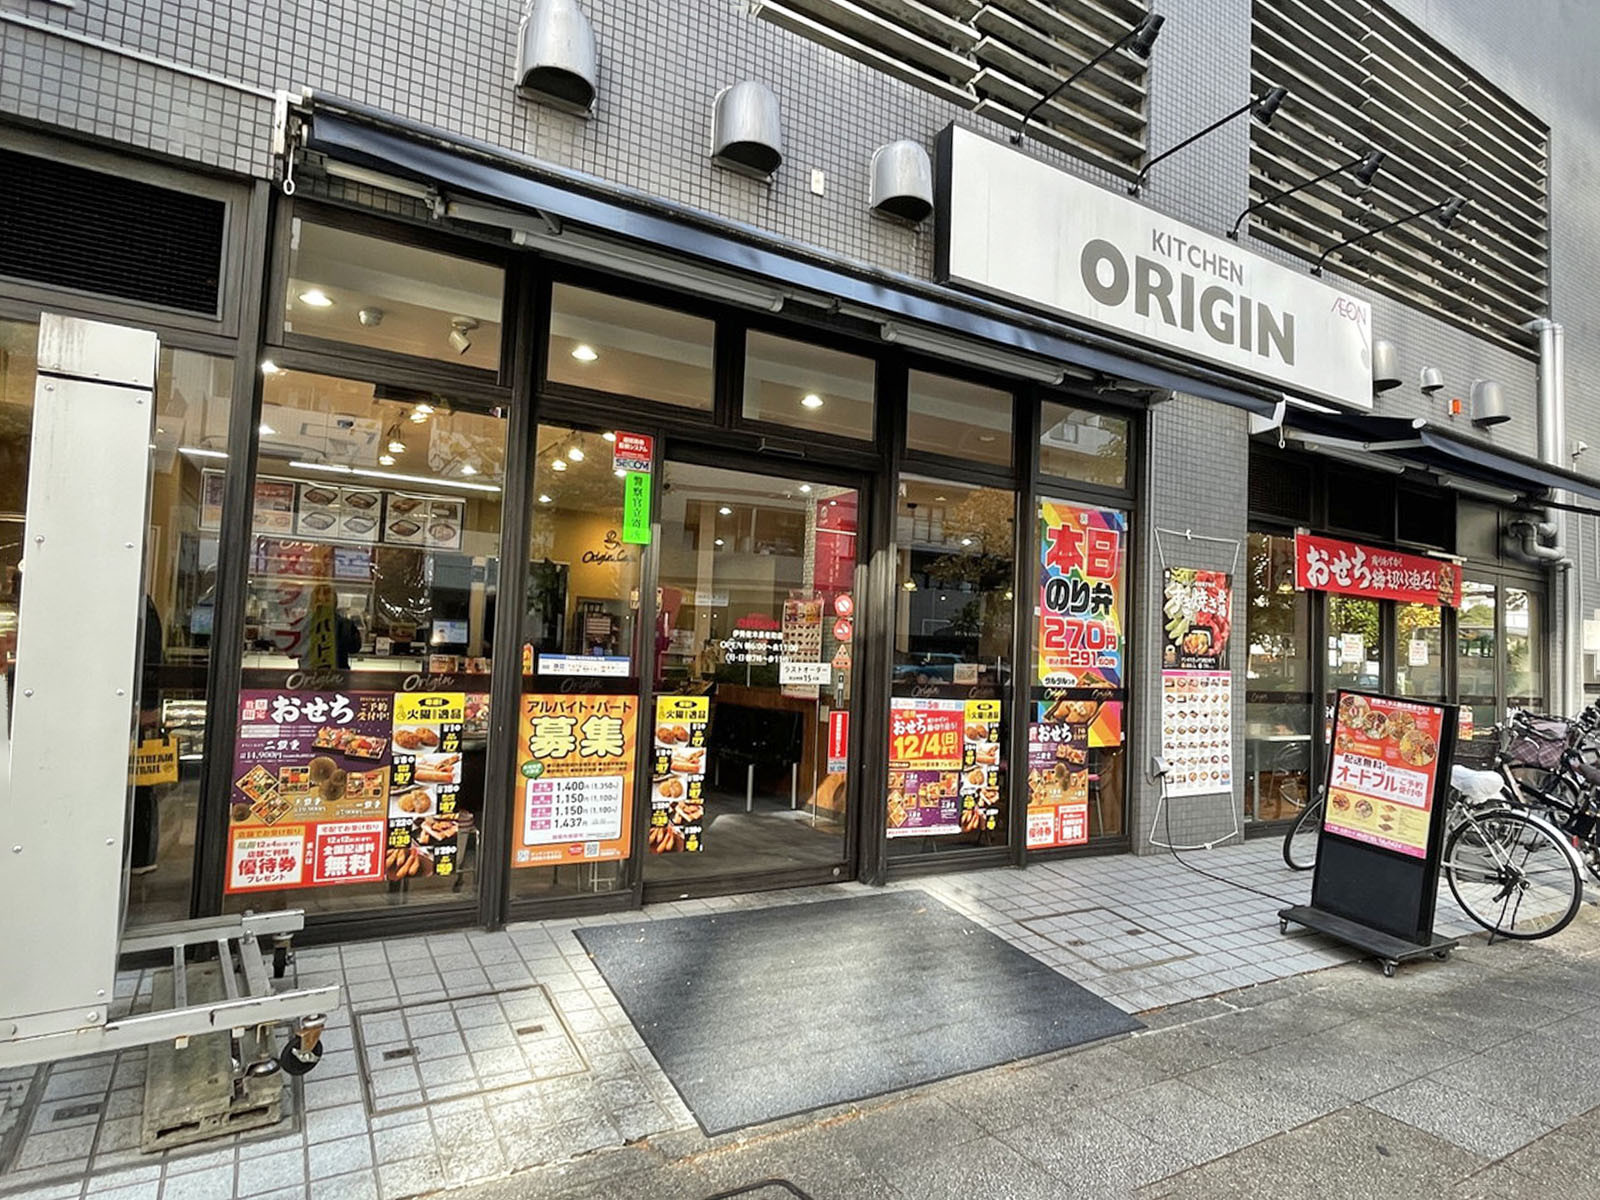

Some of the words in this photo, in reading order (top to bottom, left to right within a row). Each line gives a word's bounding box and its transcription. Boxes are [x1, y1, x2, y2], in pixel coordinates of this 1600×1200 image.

[1152, 228, 1243, 286] KITCHEN
[1080, 238, 1294, 366] ORIGIN
[616, 459, 649, 470] SECOM
[1045, 522, 1119, 580] 本日
[1306, 545, 1372, 588] おせち
[1046, 577, 1114, 616] のり弁
[286, 672, 344, 690] Origin
[785, 666, 828, 674] ラストオーダー
[403, 674, 455, 691] Origin
[271, 694, 354, 723] おせち
[528, 701, 631, 713] アルバイト・パート
[529, 715, 625, 758] 募集
[893, 718, 927, 736] おせち
[1038, 723, 1072, 742] おせち
[893, 733, 941, 760] 12/4
[1336, 765, 1398, 792] オードブル
[238, 856, 297, 876] 優待券
[324, 853, 372, 877] 無料
[246, 873, 286, 883] プレゼント
